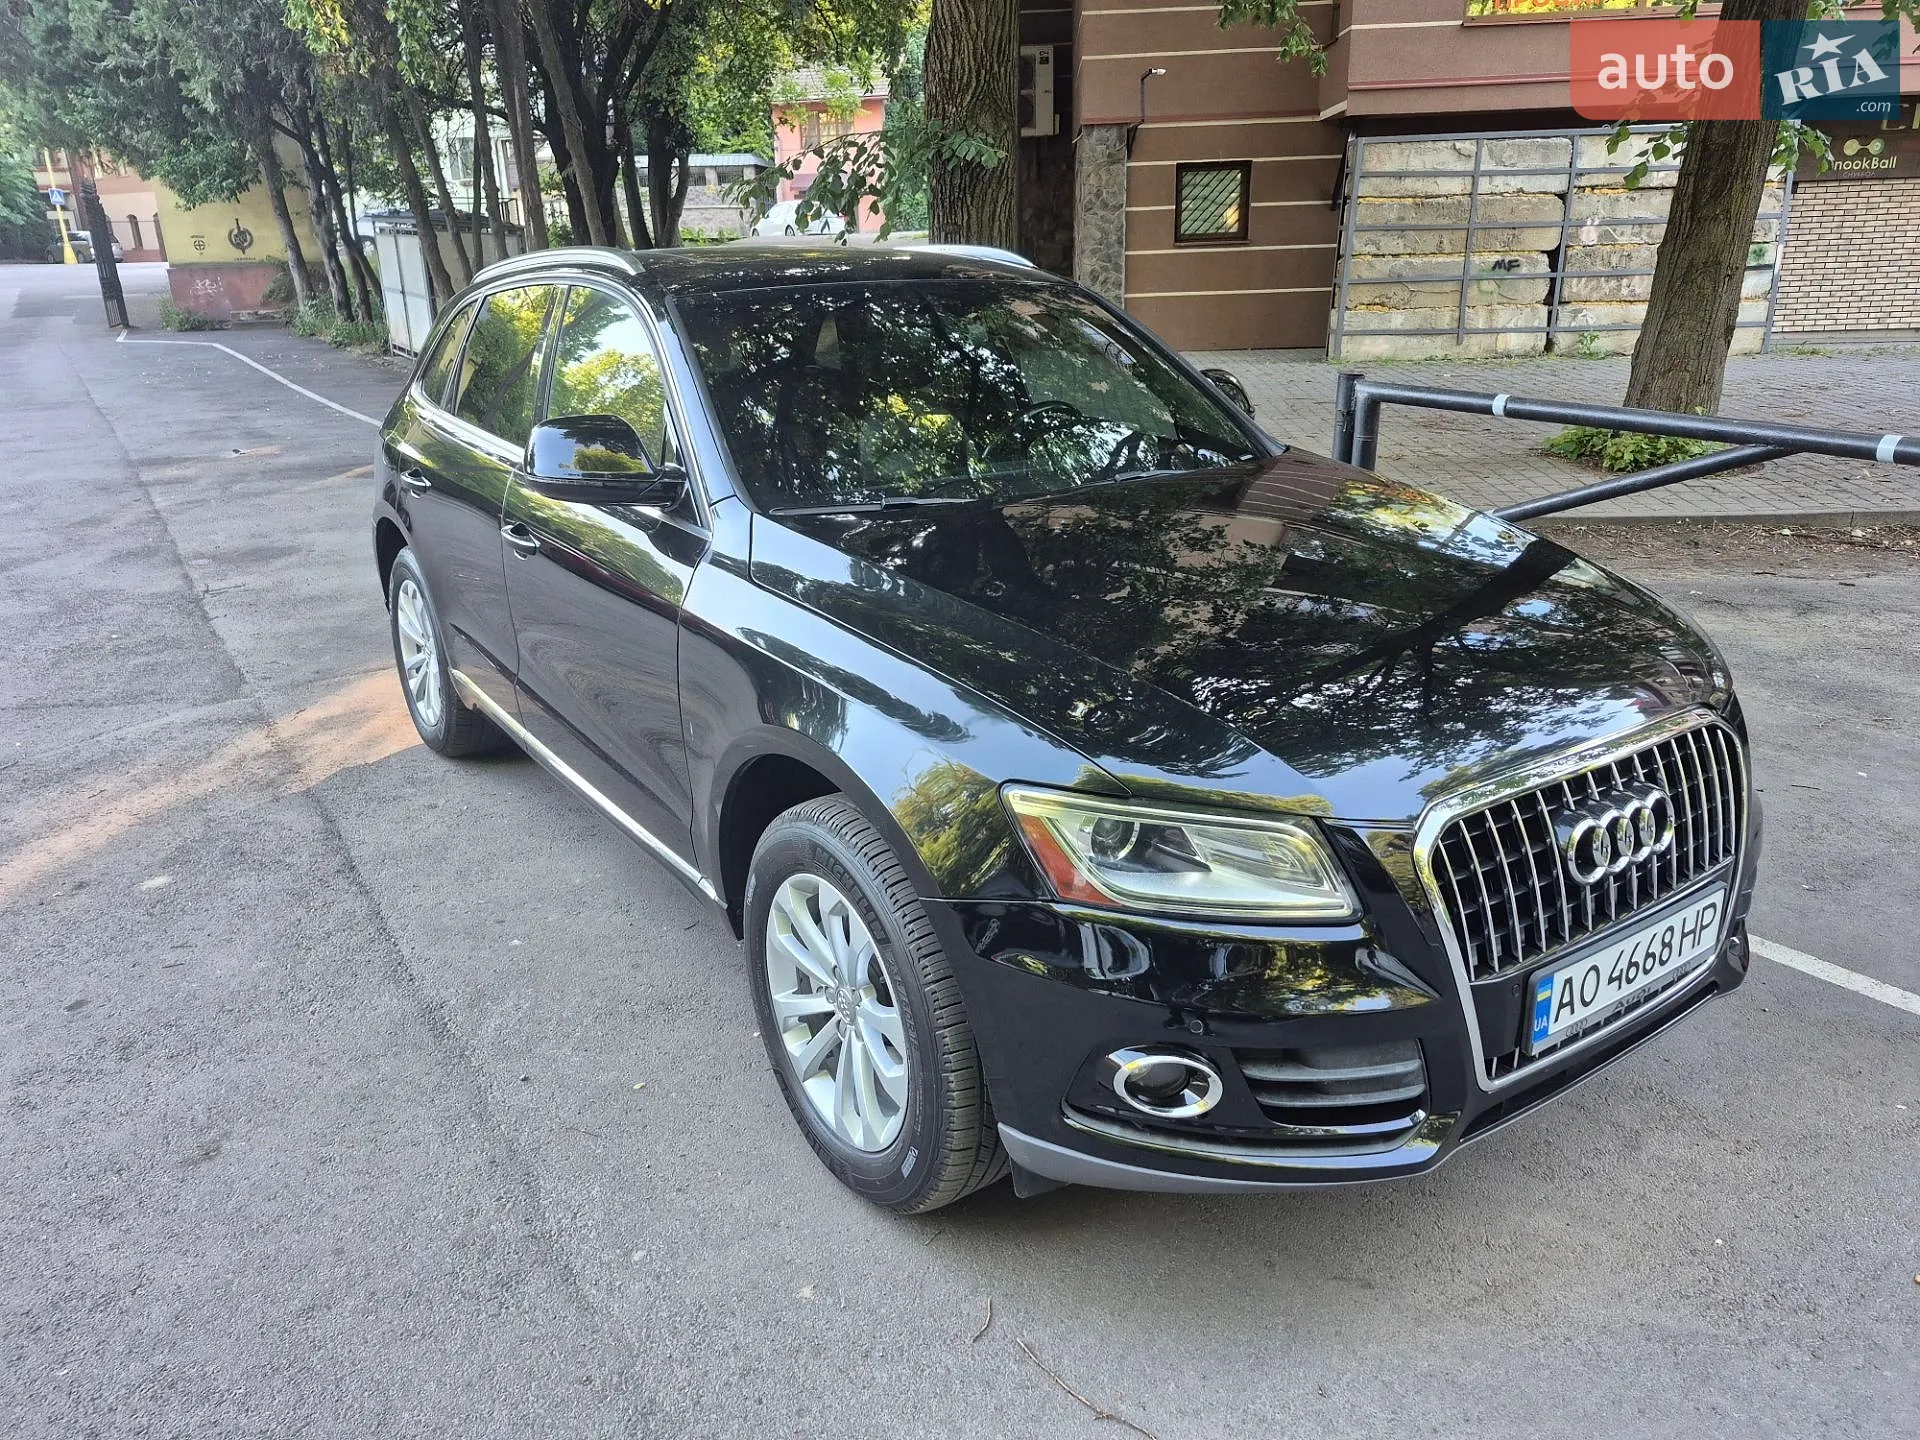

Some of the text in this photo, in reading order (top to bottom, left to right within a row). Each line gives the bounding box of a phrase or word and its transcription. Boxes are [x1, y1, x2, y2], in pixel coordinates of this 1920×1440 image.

[1834, 155, 1898, 171] nookBall
[814, 847, 890, 946] MICHELIN
[1553, 901, 1718, 1024] AO 4668 HP
[1534, 1015, 1548, 1031] UA
